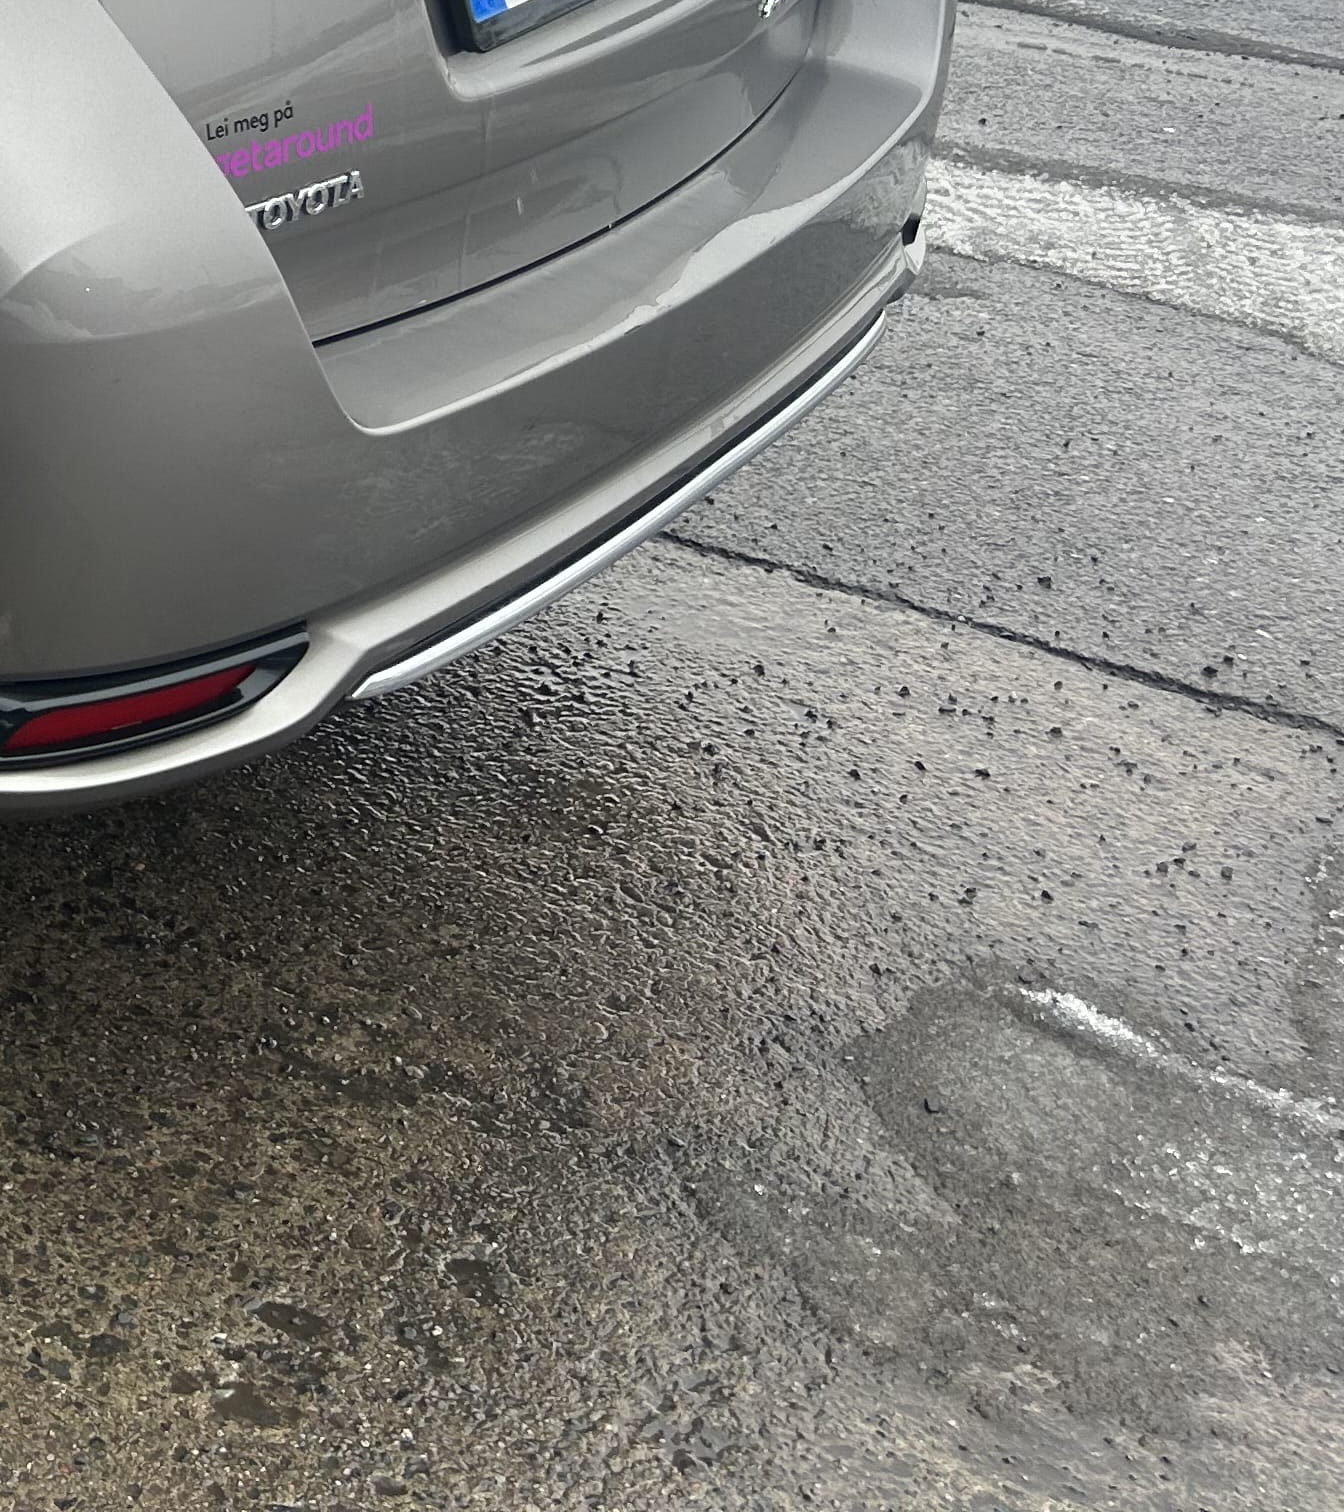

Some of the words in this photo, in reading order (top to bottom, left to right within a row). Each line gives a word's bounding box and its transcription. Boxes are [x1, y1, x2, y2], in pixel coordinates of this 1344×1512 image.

[206, 117, 229, 142] Lei
[233, 112, 269, 133] meg
[274, 100, 294, 128] på
[244, 170, 365, 230] TOYOTA
